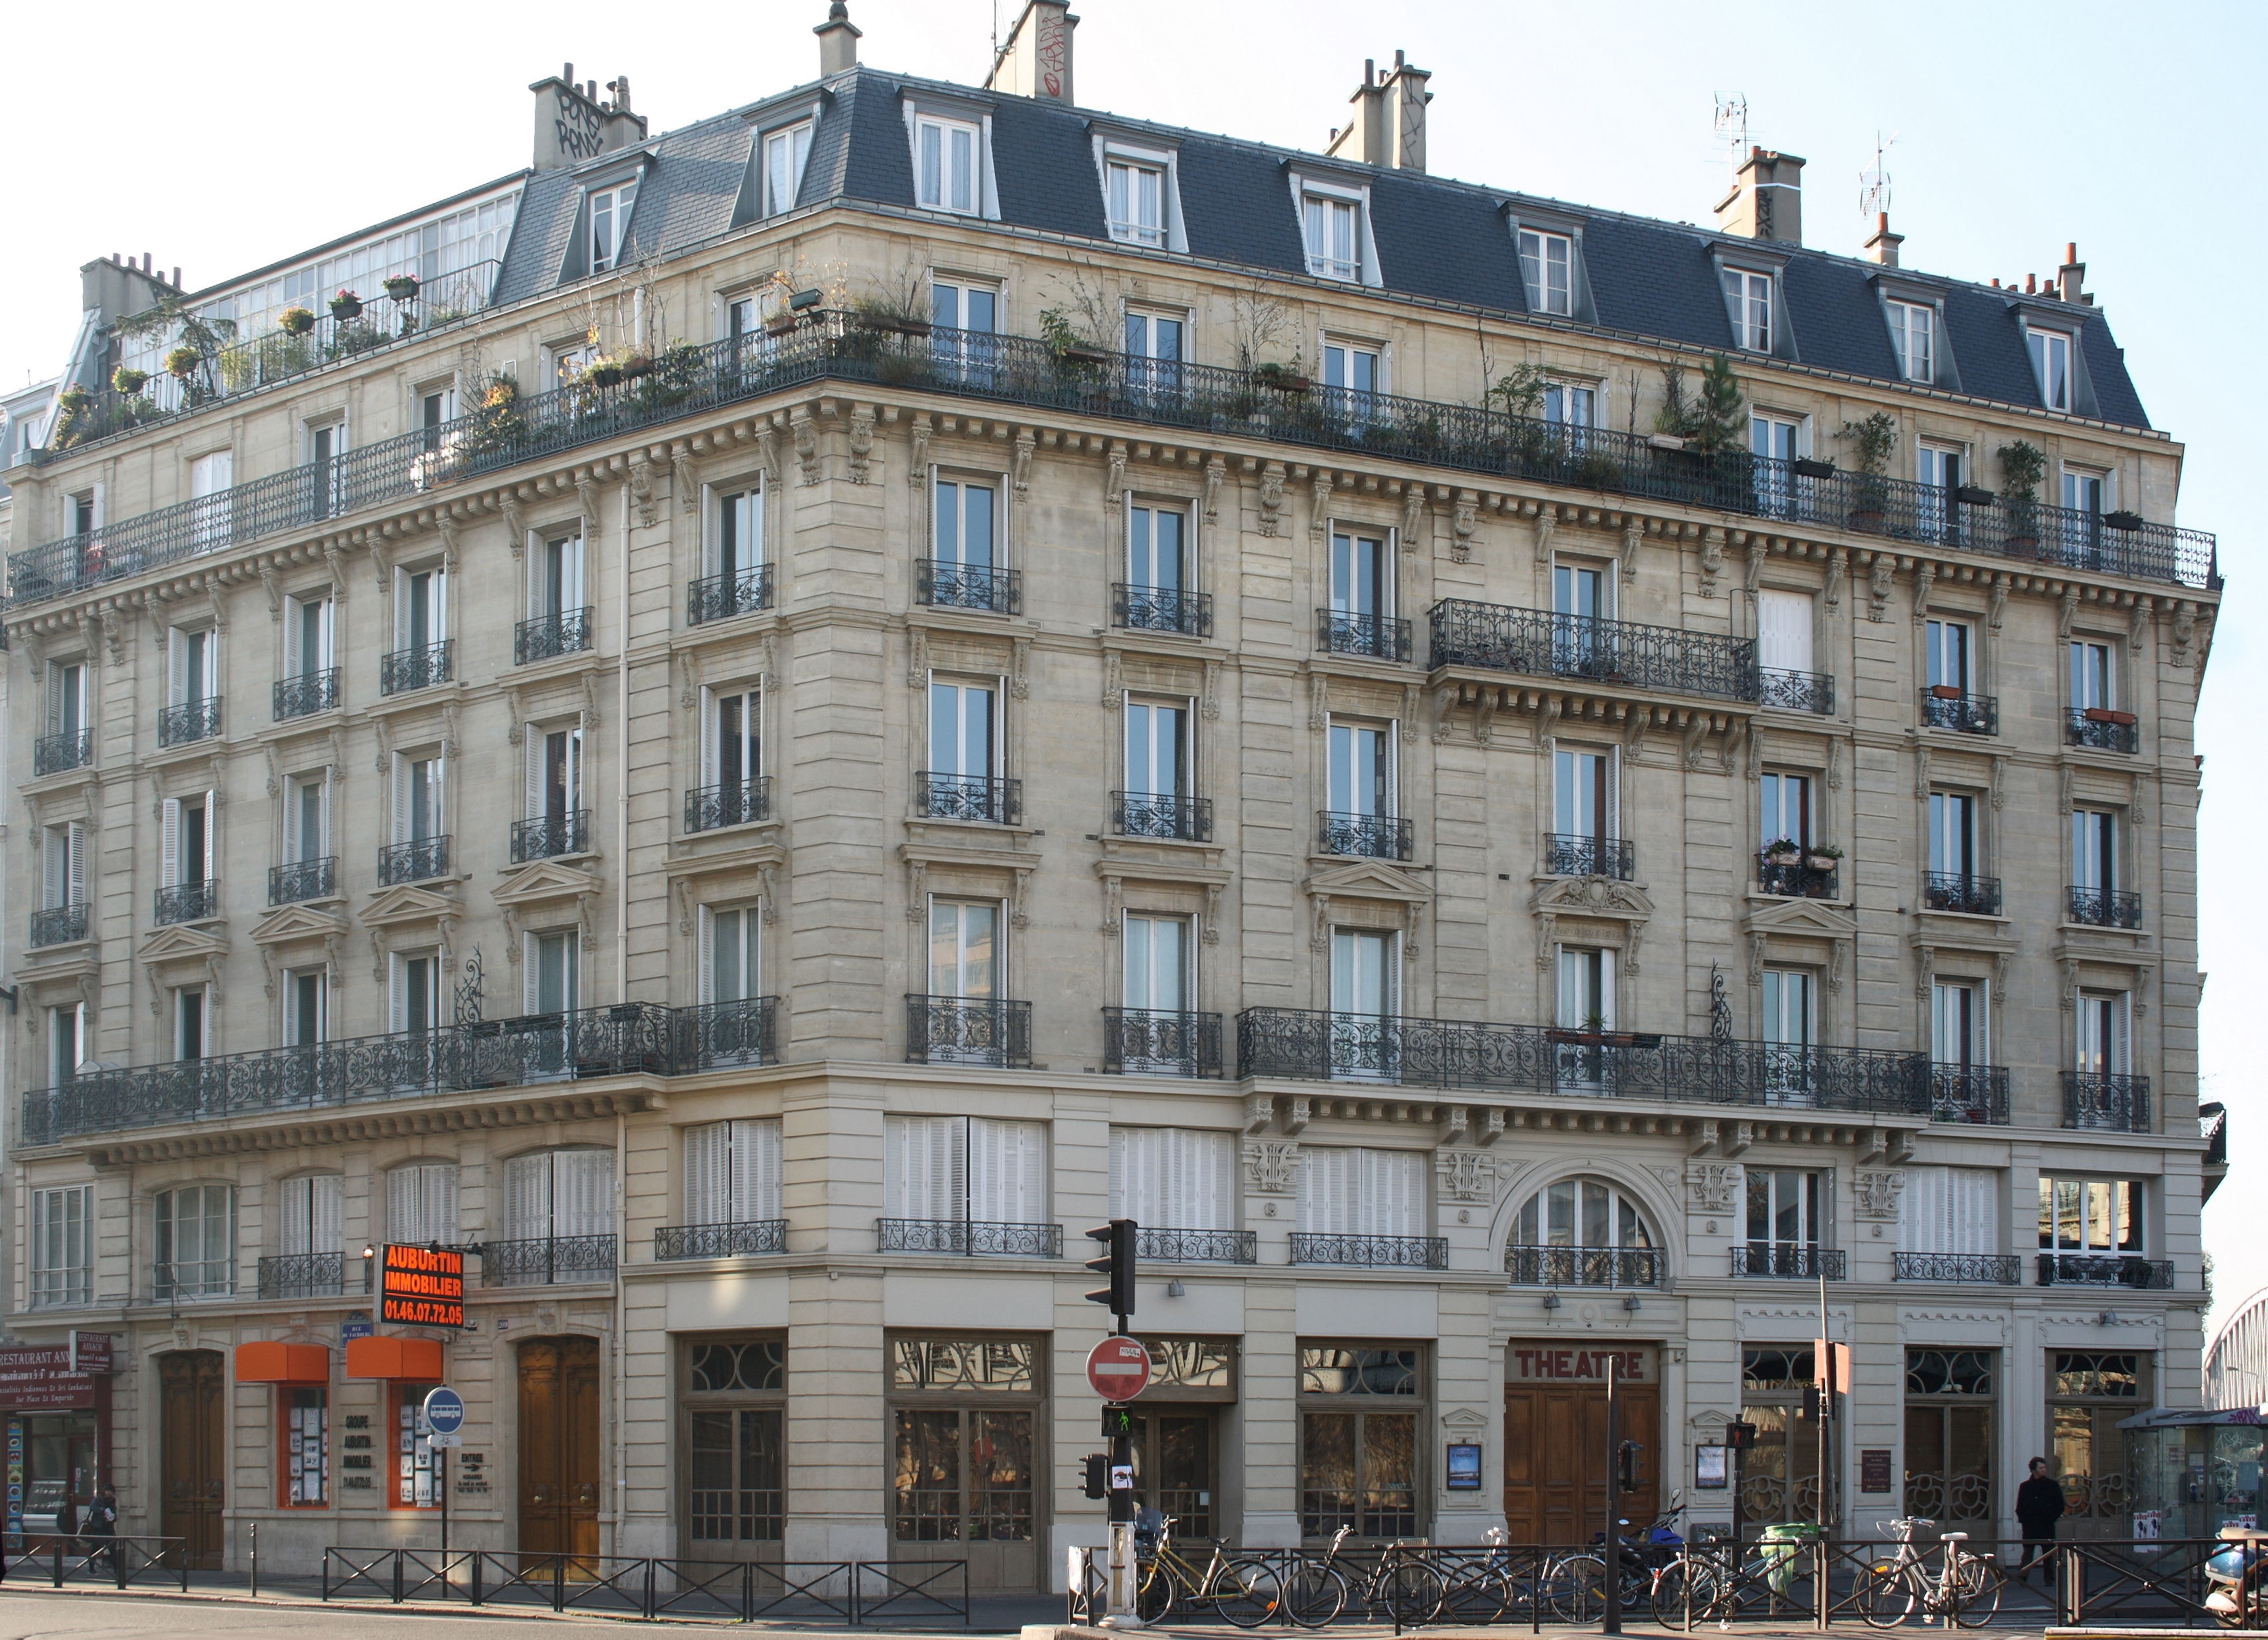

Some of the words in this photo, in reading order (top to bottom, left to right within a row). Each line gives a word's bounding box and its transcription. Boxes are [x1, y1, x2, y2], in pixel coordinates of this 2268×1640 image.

[386, 1246, 461, 1274] AUBURTIN
[384, 1271, 462, 1298] IMMOBILIER
[384, 1299, 463, 1325] 01.46.07.72.05
[78, 1333, 109, 1343] RESTAURANT
[0, 1351, 52, 1365] RESTAURANT
[1514, 1350, 1643, 1379] THEATRE
[346, 1415, 369, 1429] GROUPE
[344, 1435, 371, 1448] AUBURTIN
[461, 1452, 484, 1462] ENTREE
